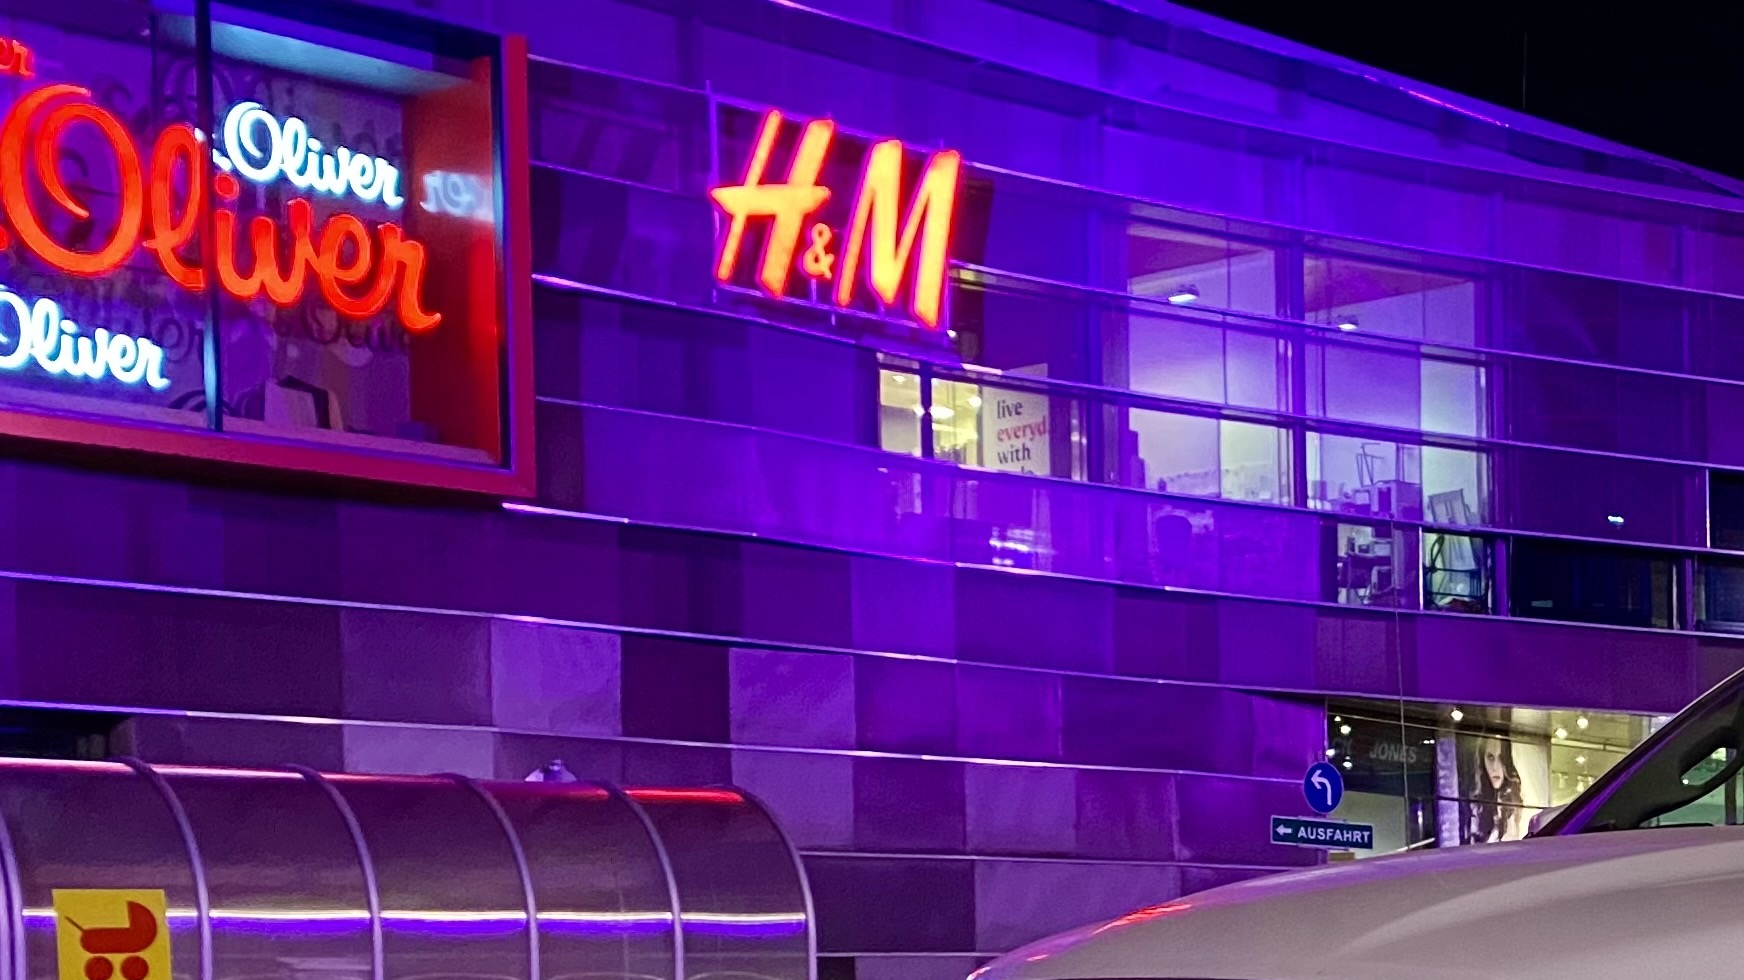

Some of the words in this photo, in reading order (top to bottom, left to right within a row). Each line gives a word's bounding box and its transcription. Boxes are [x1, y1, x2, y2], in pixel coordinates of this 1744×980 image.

[710, 109, 962, 330] H&M
[996, 399, 1024, 419] live
[996, 442, 1032, 465] with
[1368, 742, 1418, 763] JONES
[1297, 826, 1371, 843] AUSFAHRT
